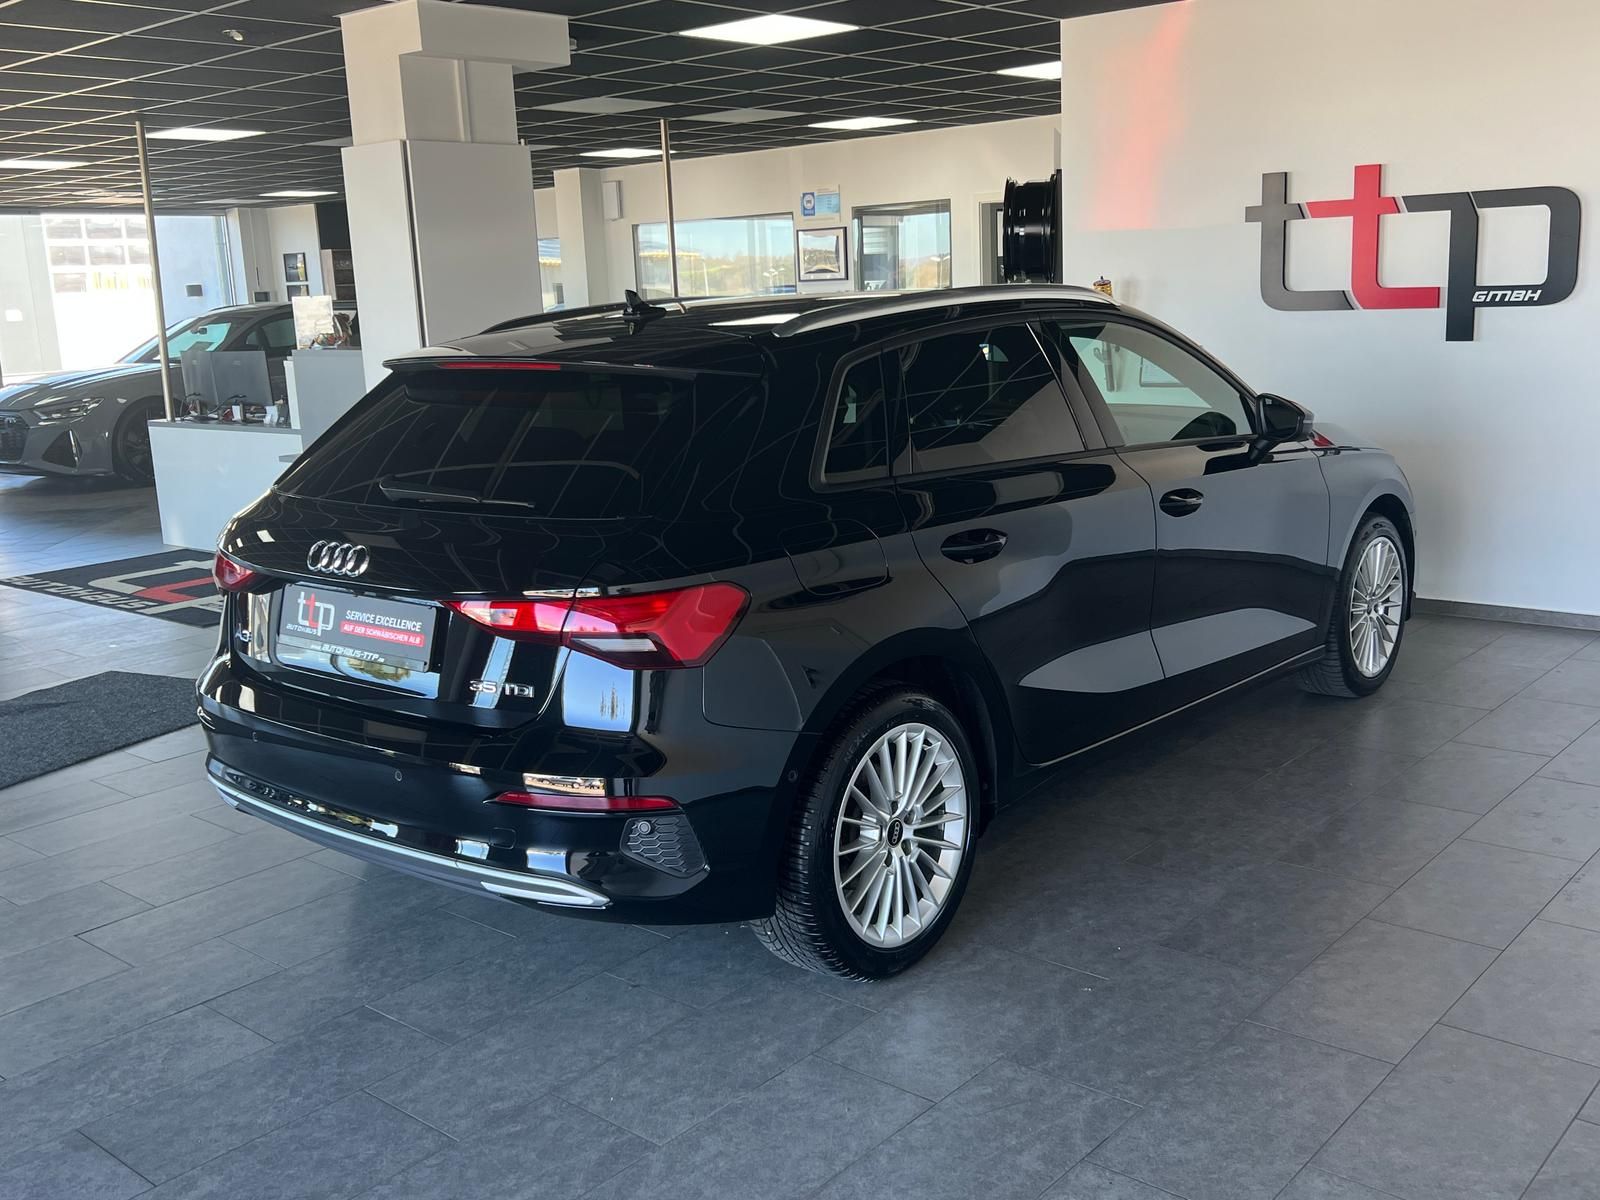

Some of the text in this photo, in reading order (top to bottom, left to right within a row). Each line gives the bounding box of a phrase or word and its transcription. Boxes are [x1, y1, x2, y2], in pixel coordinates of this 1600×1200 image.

[1245, 164, 1581, 341] ttp
[298, 592, 335, 637] ttp
[345, 610, 422, 632] SERVICE EXCELLENCE
[343, 623, 354, 632] AUF
[354, 626, 366, 634] DER
[409, 635, 421, 645] ALB
[469, 680, 535, 698] 35 TDI
